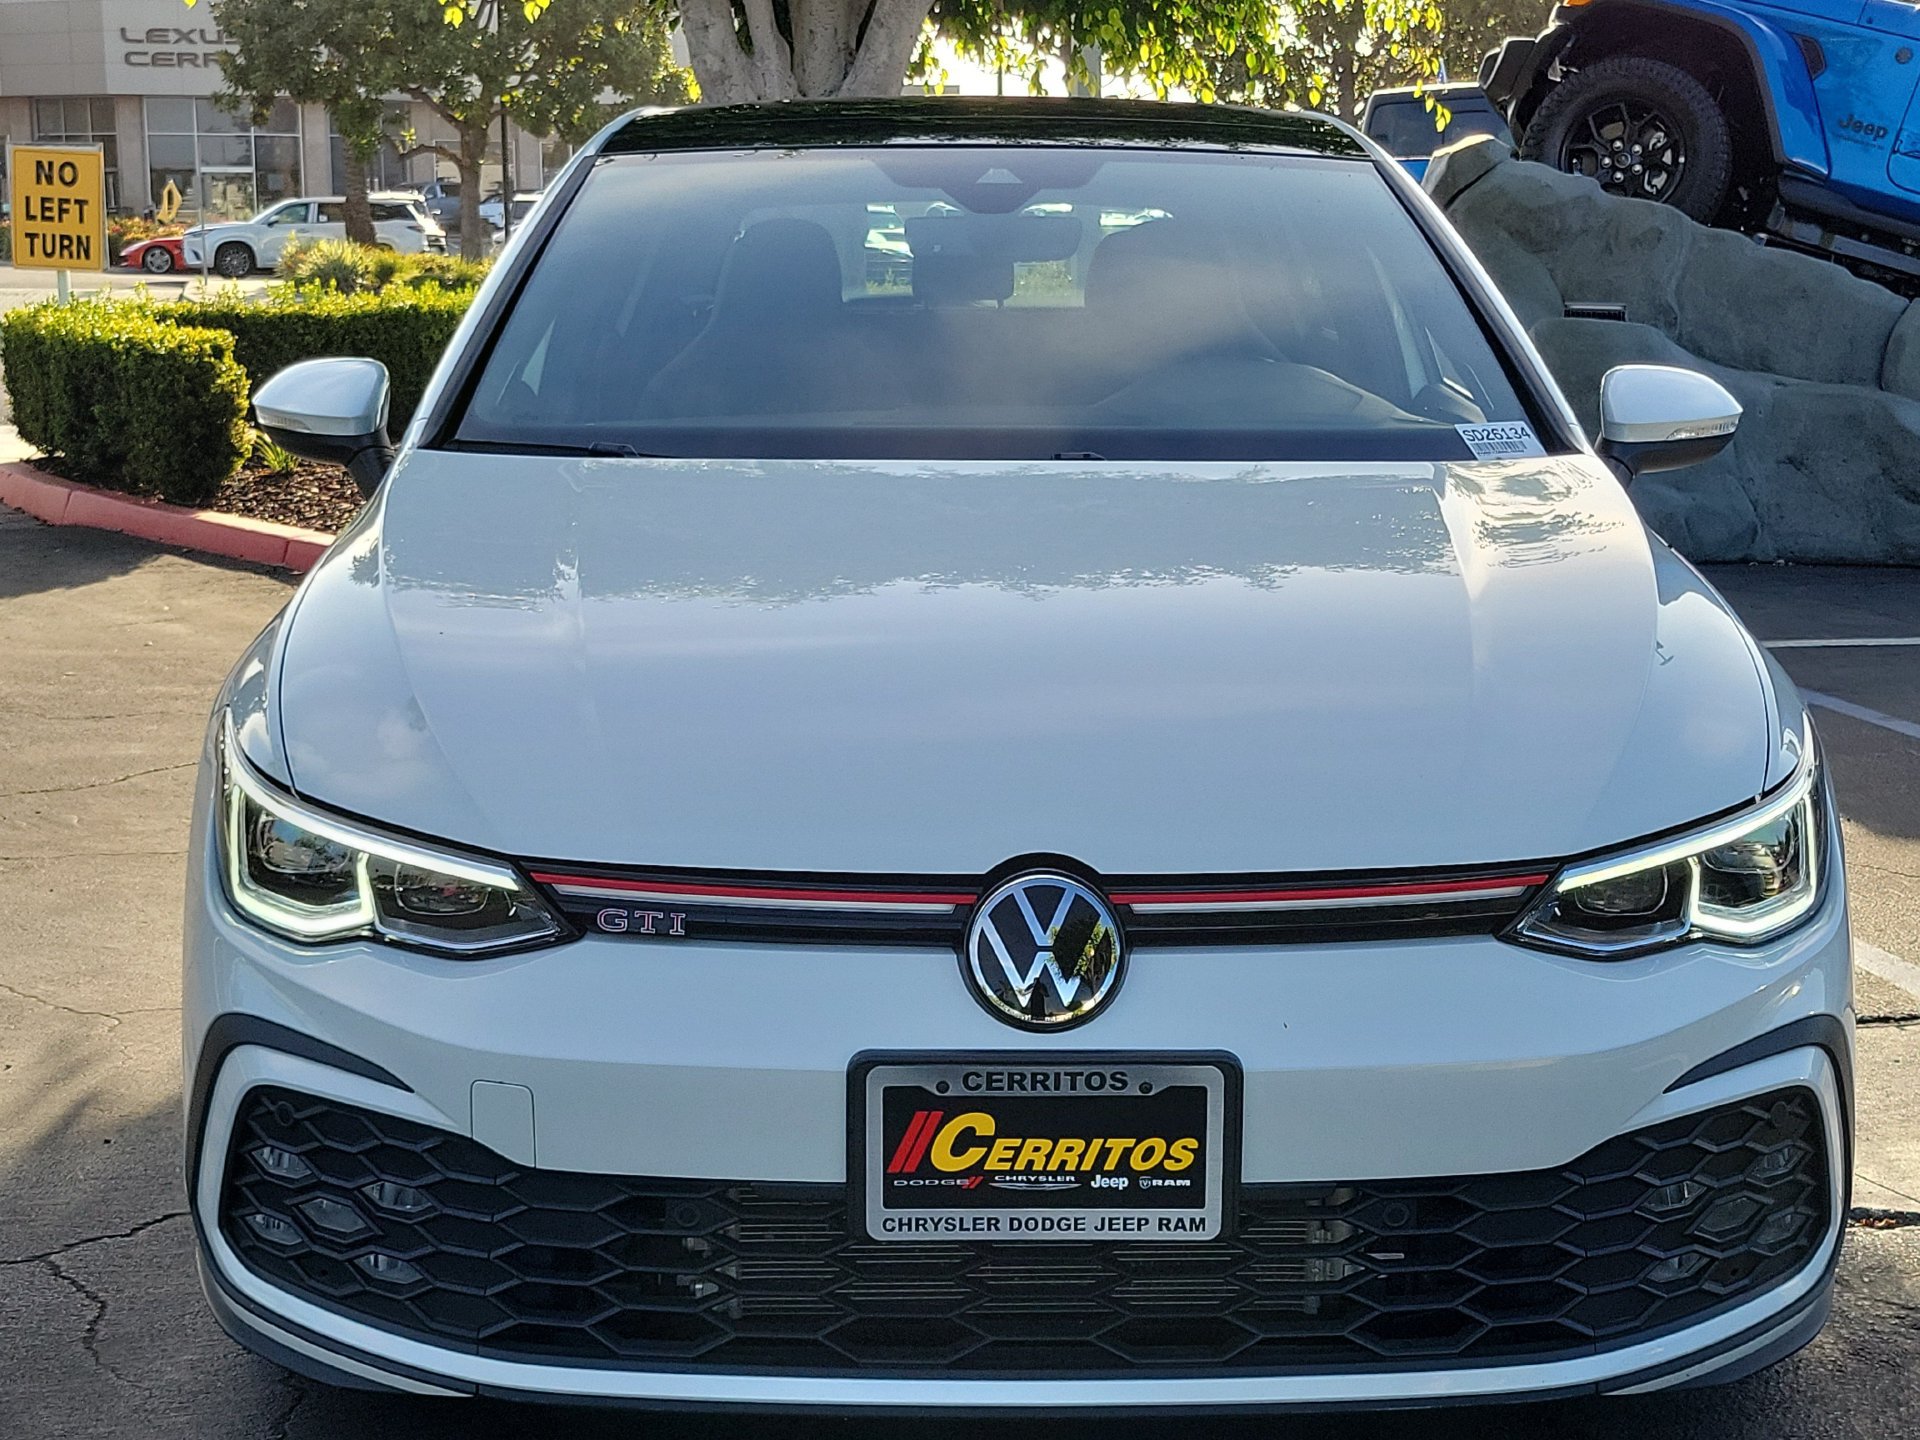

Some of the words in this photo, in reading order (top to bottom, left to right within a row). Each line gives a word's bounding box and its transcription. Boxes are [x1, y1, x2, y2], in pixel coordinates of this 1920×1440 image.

[1838, 113, 1888, 142] Jeep
[35, 160, 79, 187] NO
[25, 195, 89, 224] LEFT
[24, 232, 91, 260] TURN
[1462, 426, 1531, 441] SD26134
[597, 908, 686, 935] GTI
[961, 1071, 1129, 1092] CERRITOS
[893, 1178, 970, 1187] DODGE
[994, 1174, 1076, 1183] CHRYSLER
[1090, 1174, 1130, 1190] Jeep
[1152, 1179, 1191, 1187] RAM
[881, 1216, 1001, 1233] CHRYSLER
[1008, 1216, 1087, 1233] DODGE
[1093, 1216, 1150, 1233] JEEP
[1157, 1216, 1206, 1233] RAM
